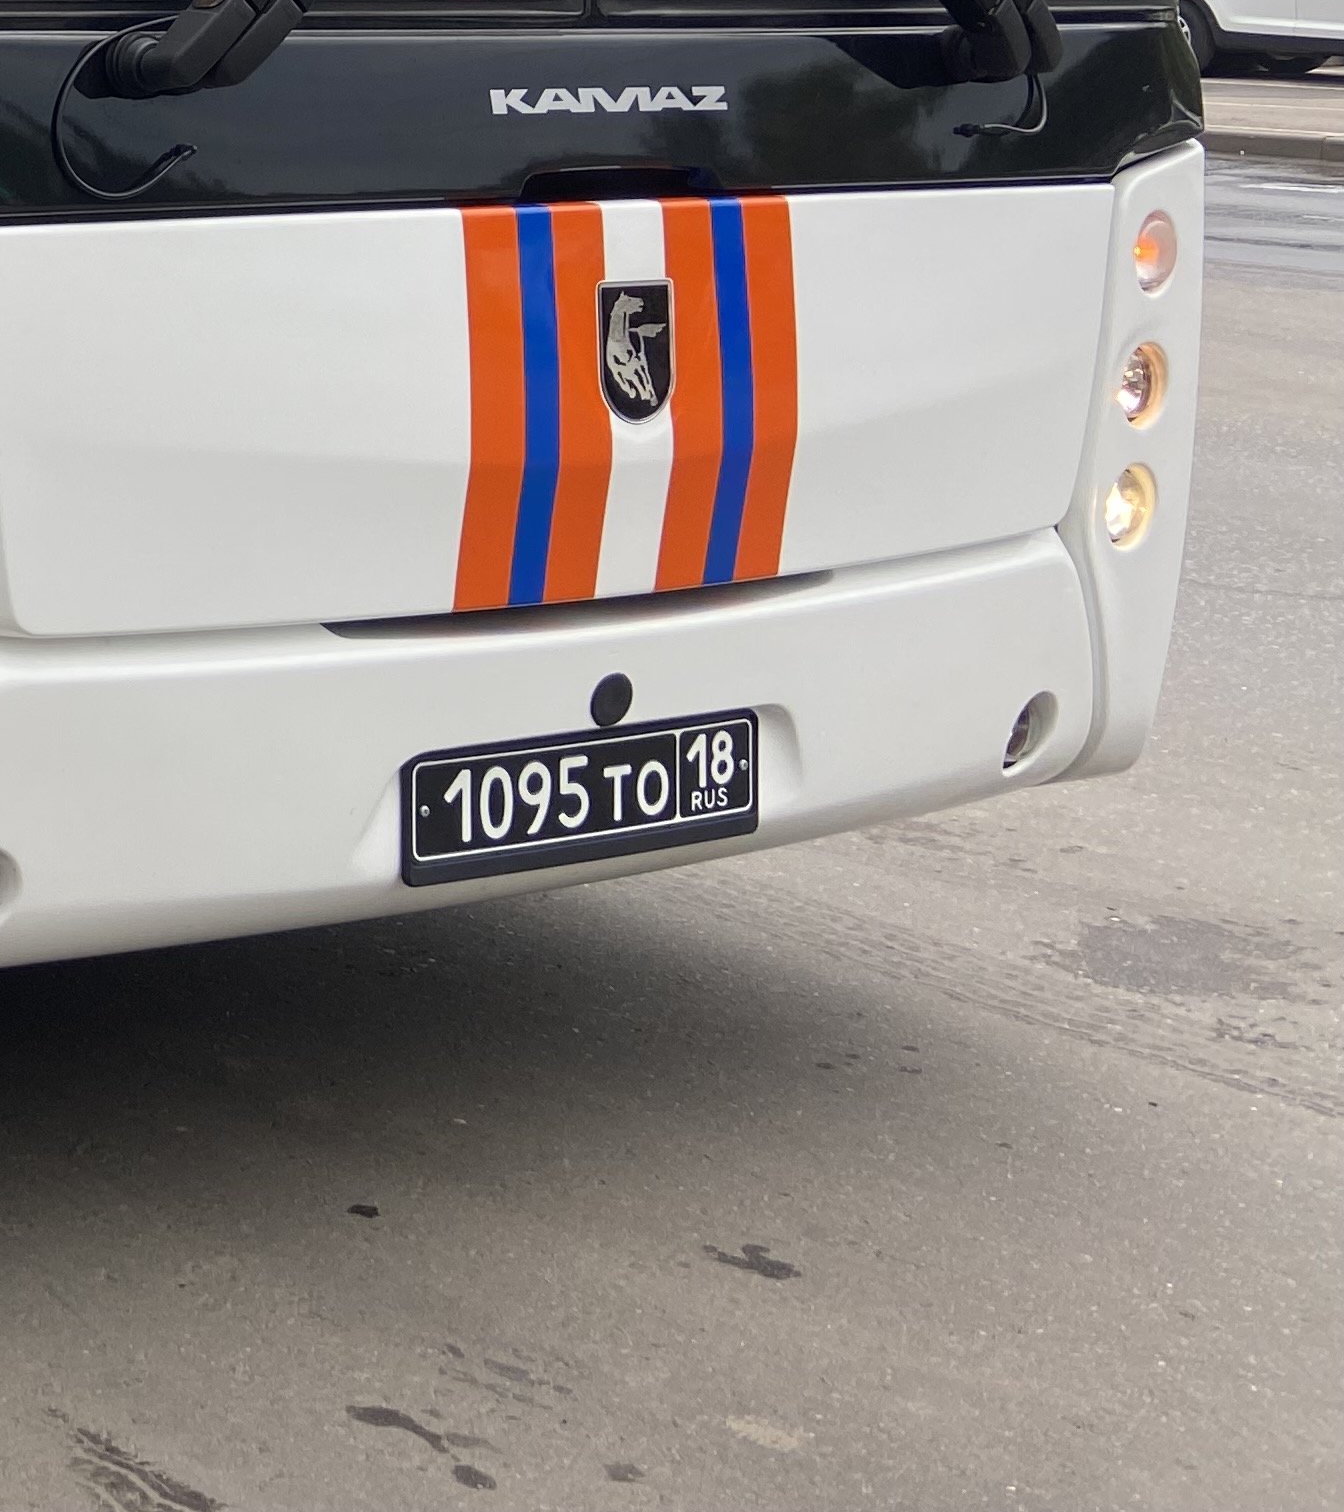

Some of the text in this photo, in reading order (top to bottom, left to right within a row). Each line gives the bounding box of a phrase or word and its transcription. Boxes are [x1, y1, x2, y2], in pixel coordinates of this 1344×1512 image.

[489, 86, 728, 115] KAMAZ
[443, 754, 591, 844] 1095
[685, 730, 735, 789] 18
[691, 787, 729, 812] RUS
